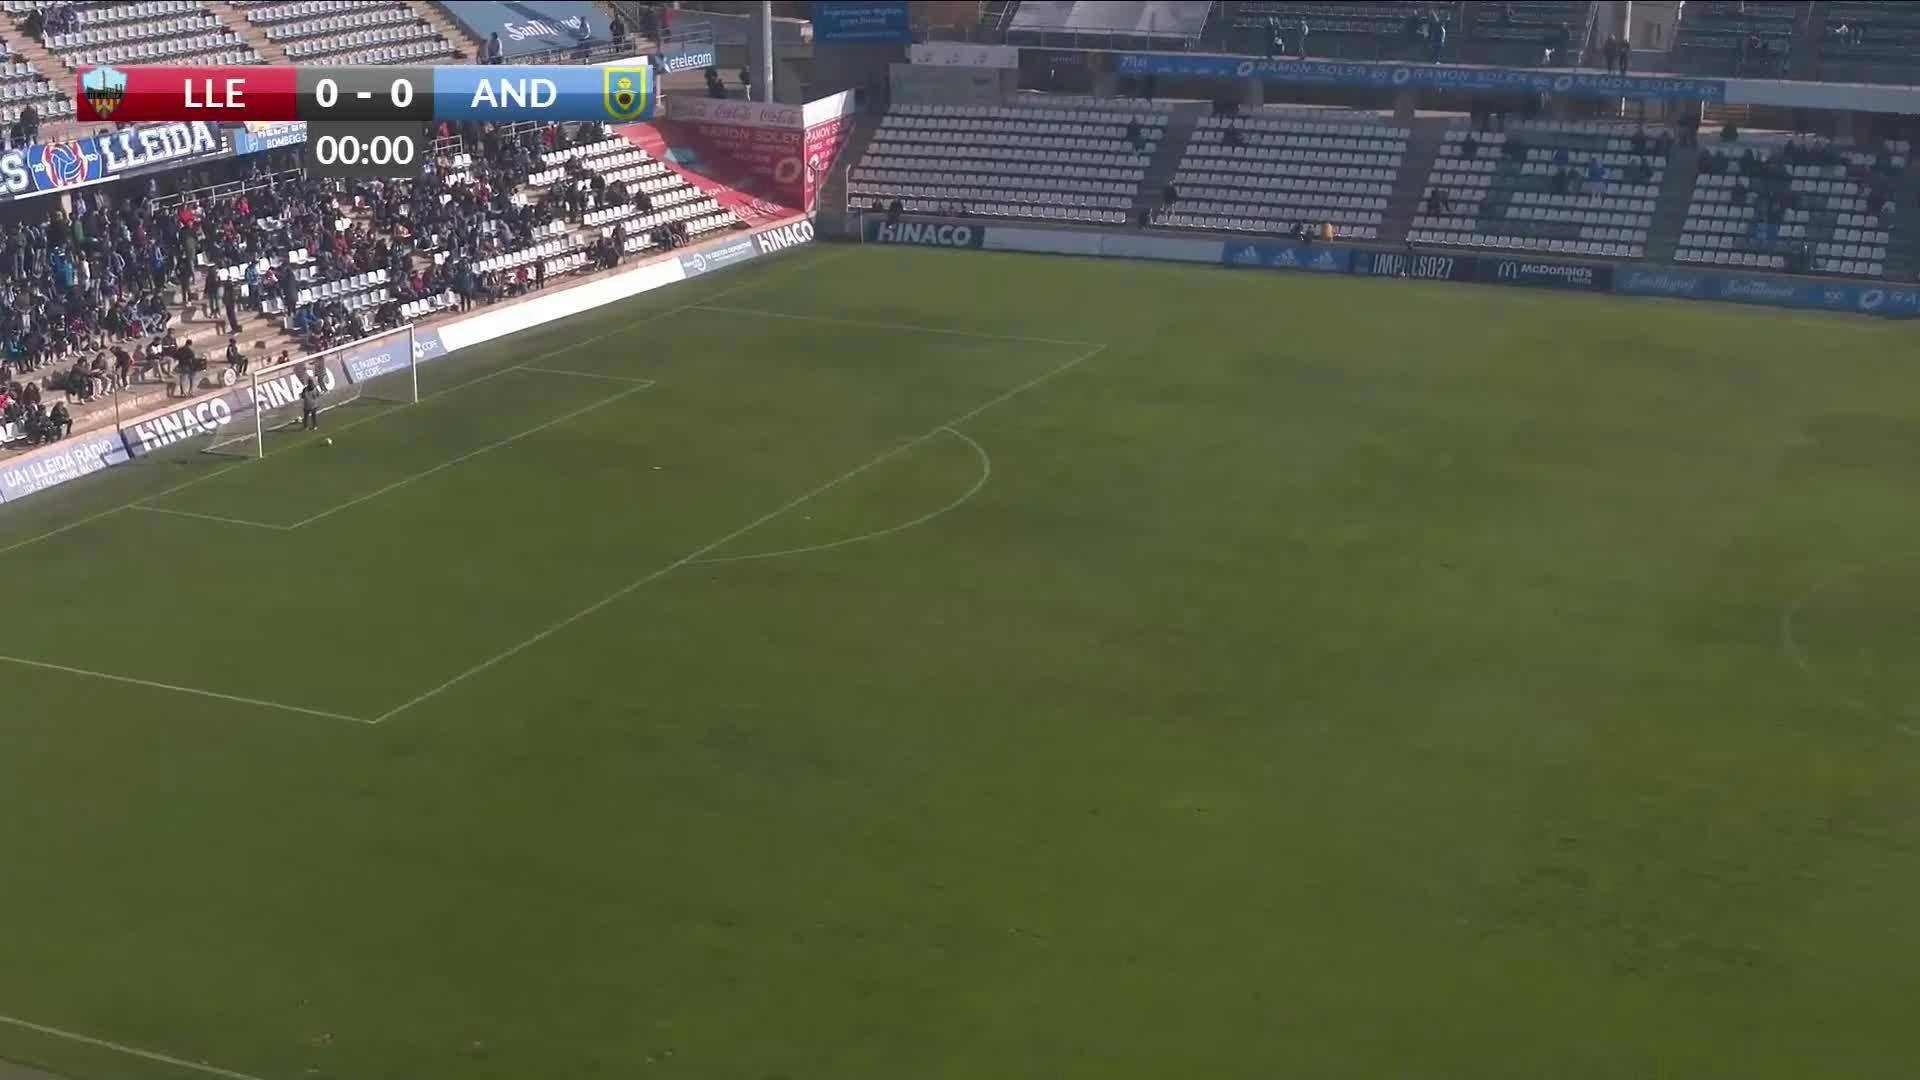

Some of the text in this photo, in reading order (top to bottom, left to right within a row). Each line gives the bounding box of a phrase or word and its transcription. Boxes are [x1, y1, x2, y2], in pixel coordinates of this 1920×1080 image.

[100, 121, 216, 173] LLEIDA
[757, 220, 815, 254] HINACO
[246, 367, 336, 412] HINAO
[135, 397, 232, 451] HINACO
[30, 450, 76, 478] LLEIDA
